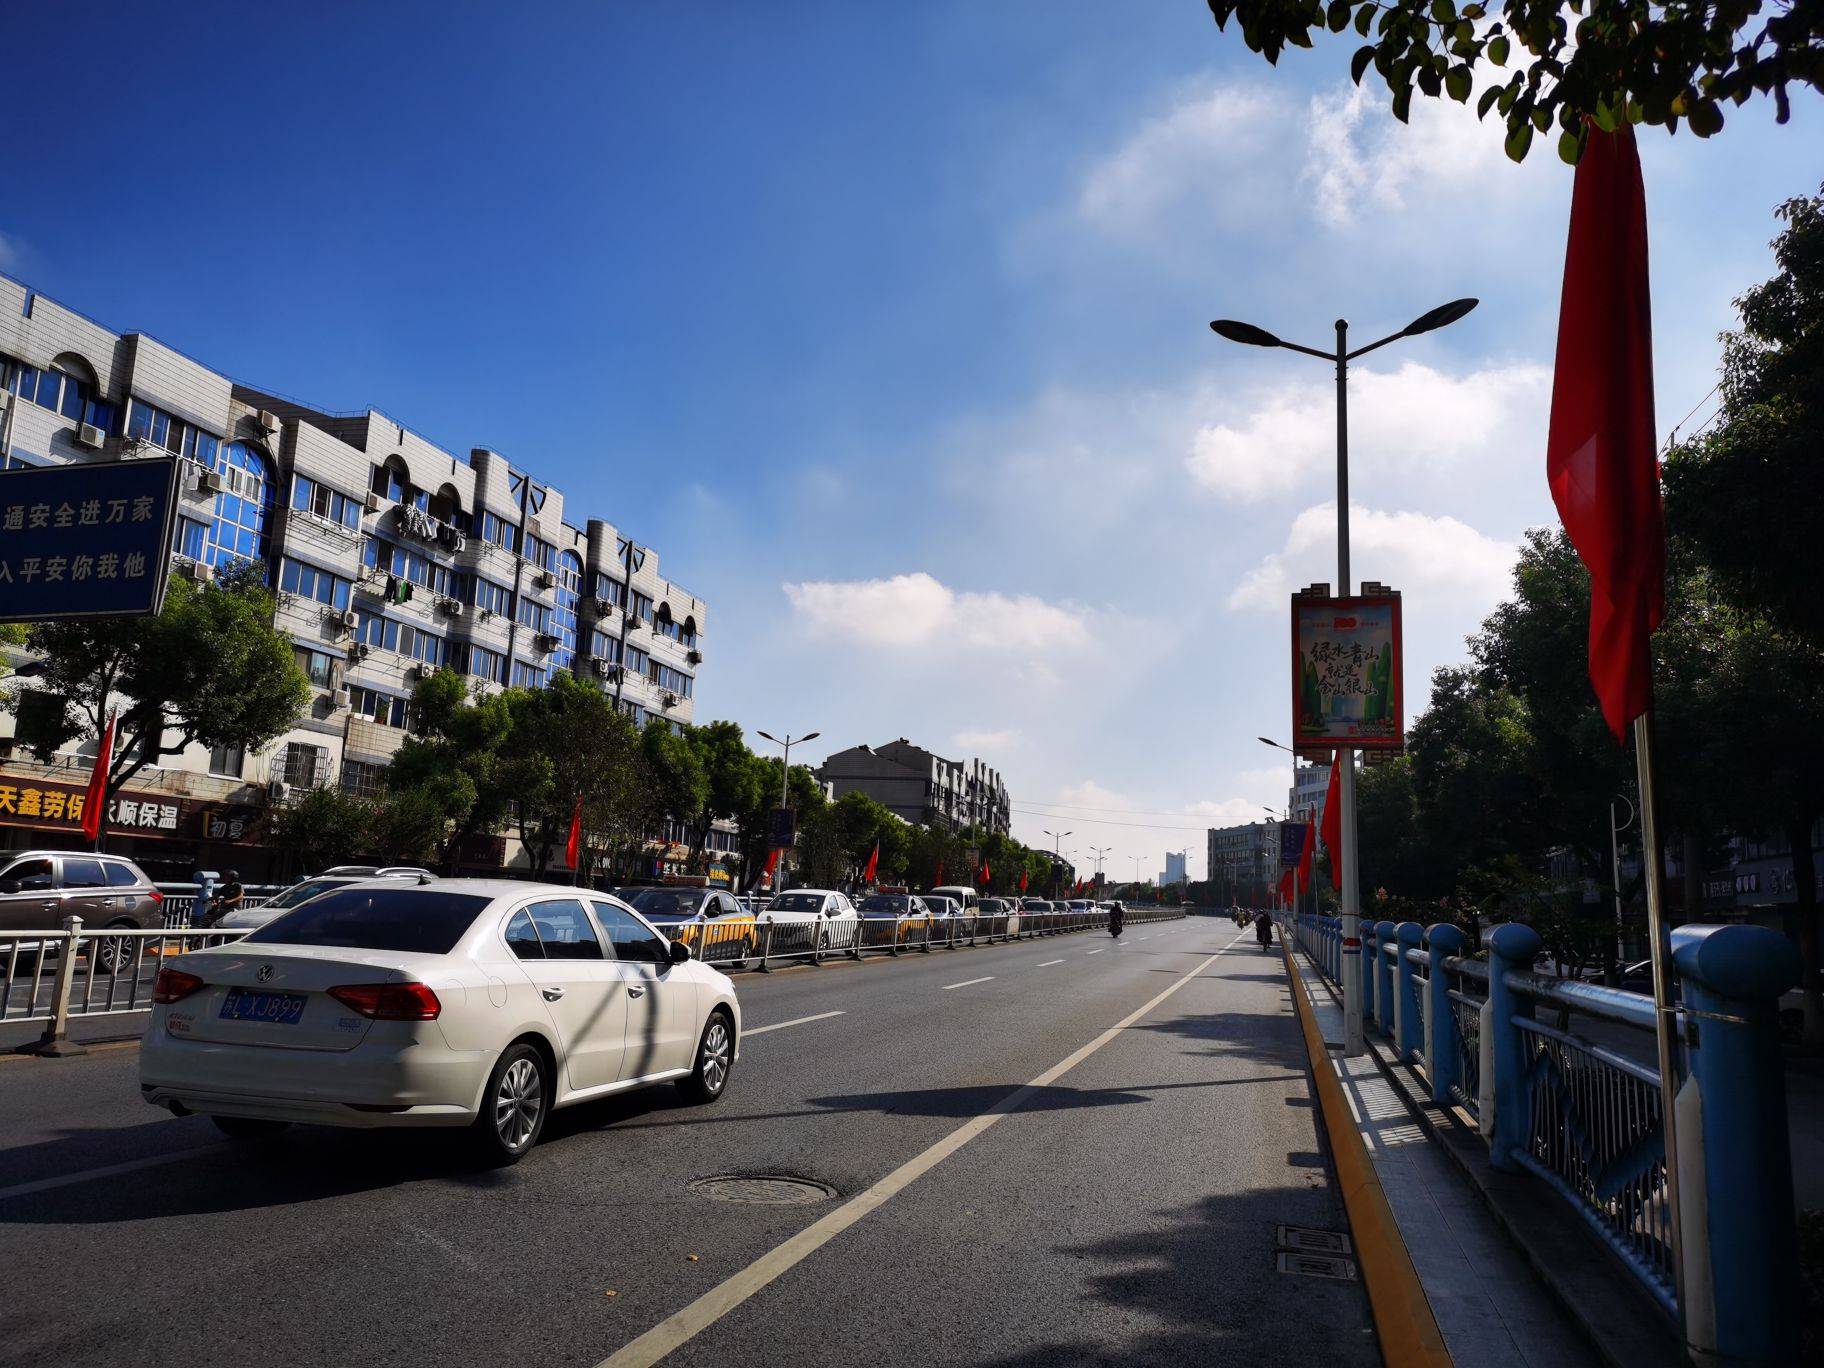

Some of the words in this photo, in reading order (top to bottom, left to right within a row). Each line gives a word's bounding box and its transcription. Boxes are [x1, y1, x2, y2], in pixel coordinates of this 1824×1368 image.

[3, 496, 154, 530] 通安全进万家
[0, 552, 146, 584] 入平安你我他
